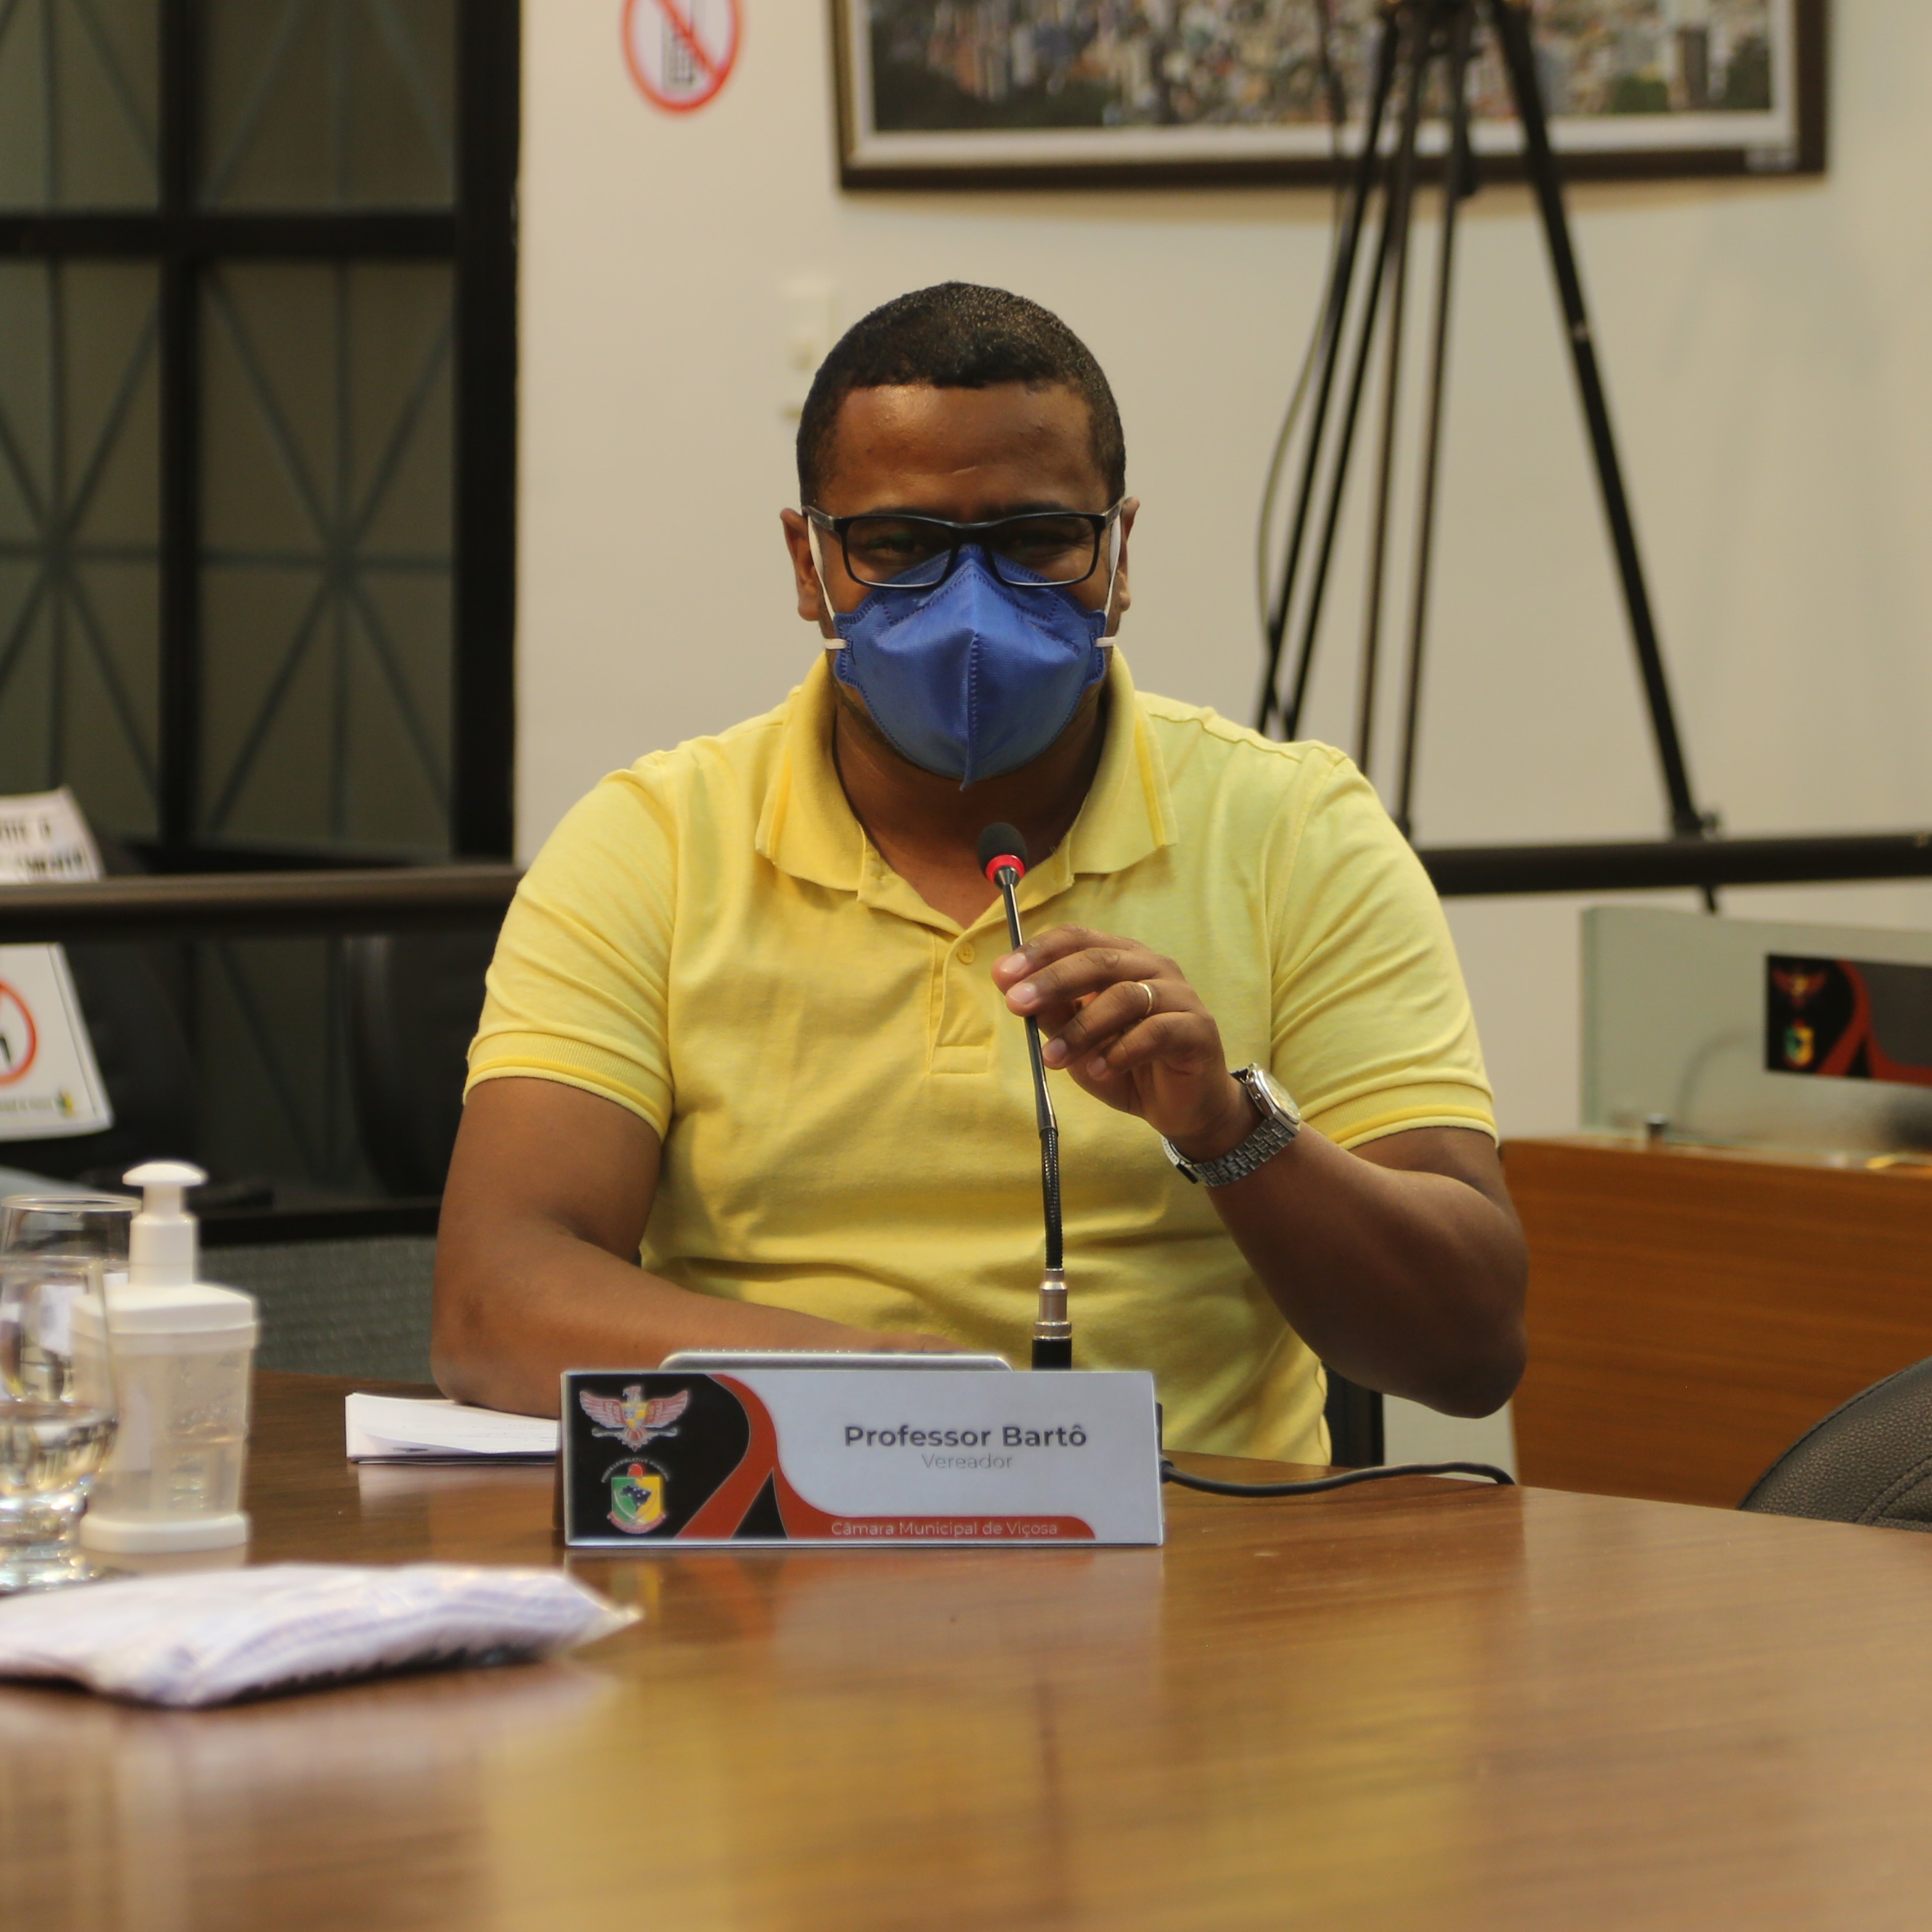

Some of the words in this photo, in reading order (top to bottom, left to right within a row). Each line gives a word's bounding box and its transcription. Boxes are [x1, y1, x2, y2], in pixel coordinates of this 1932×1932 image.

[844, 1425, 991, 1447] Professor
[1002, 1424, 1086, 1447] Bartô
[922, 1453, 1013, 1469] Vereador
[831, 1522, 894, 1535] Câmara
[899, 1522, 977, 1537] Municipal
[982, 1522, 1002, 1535] de
[1006, 1522, 1058, 1538] Viçosa
